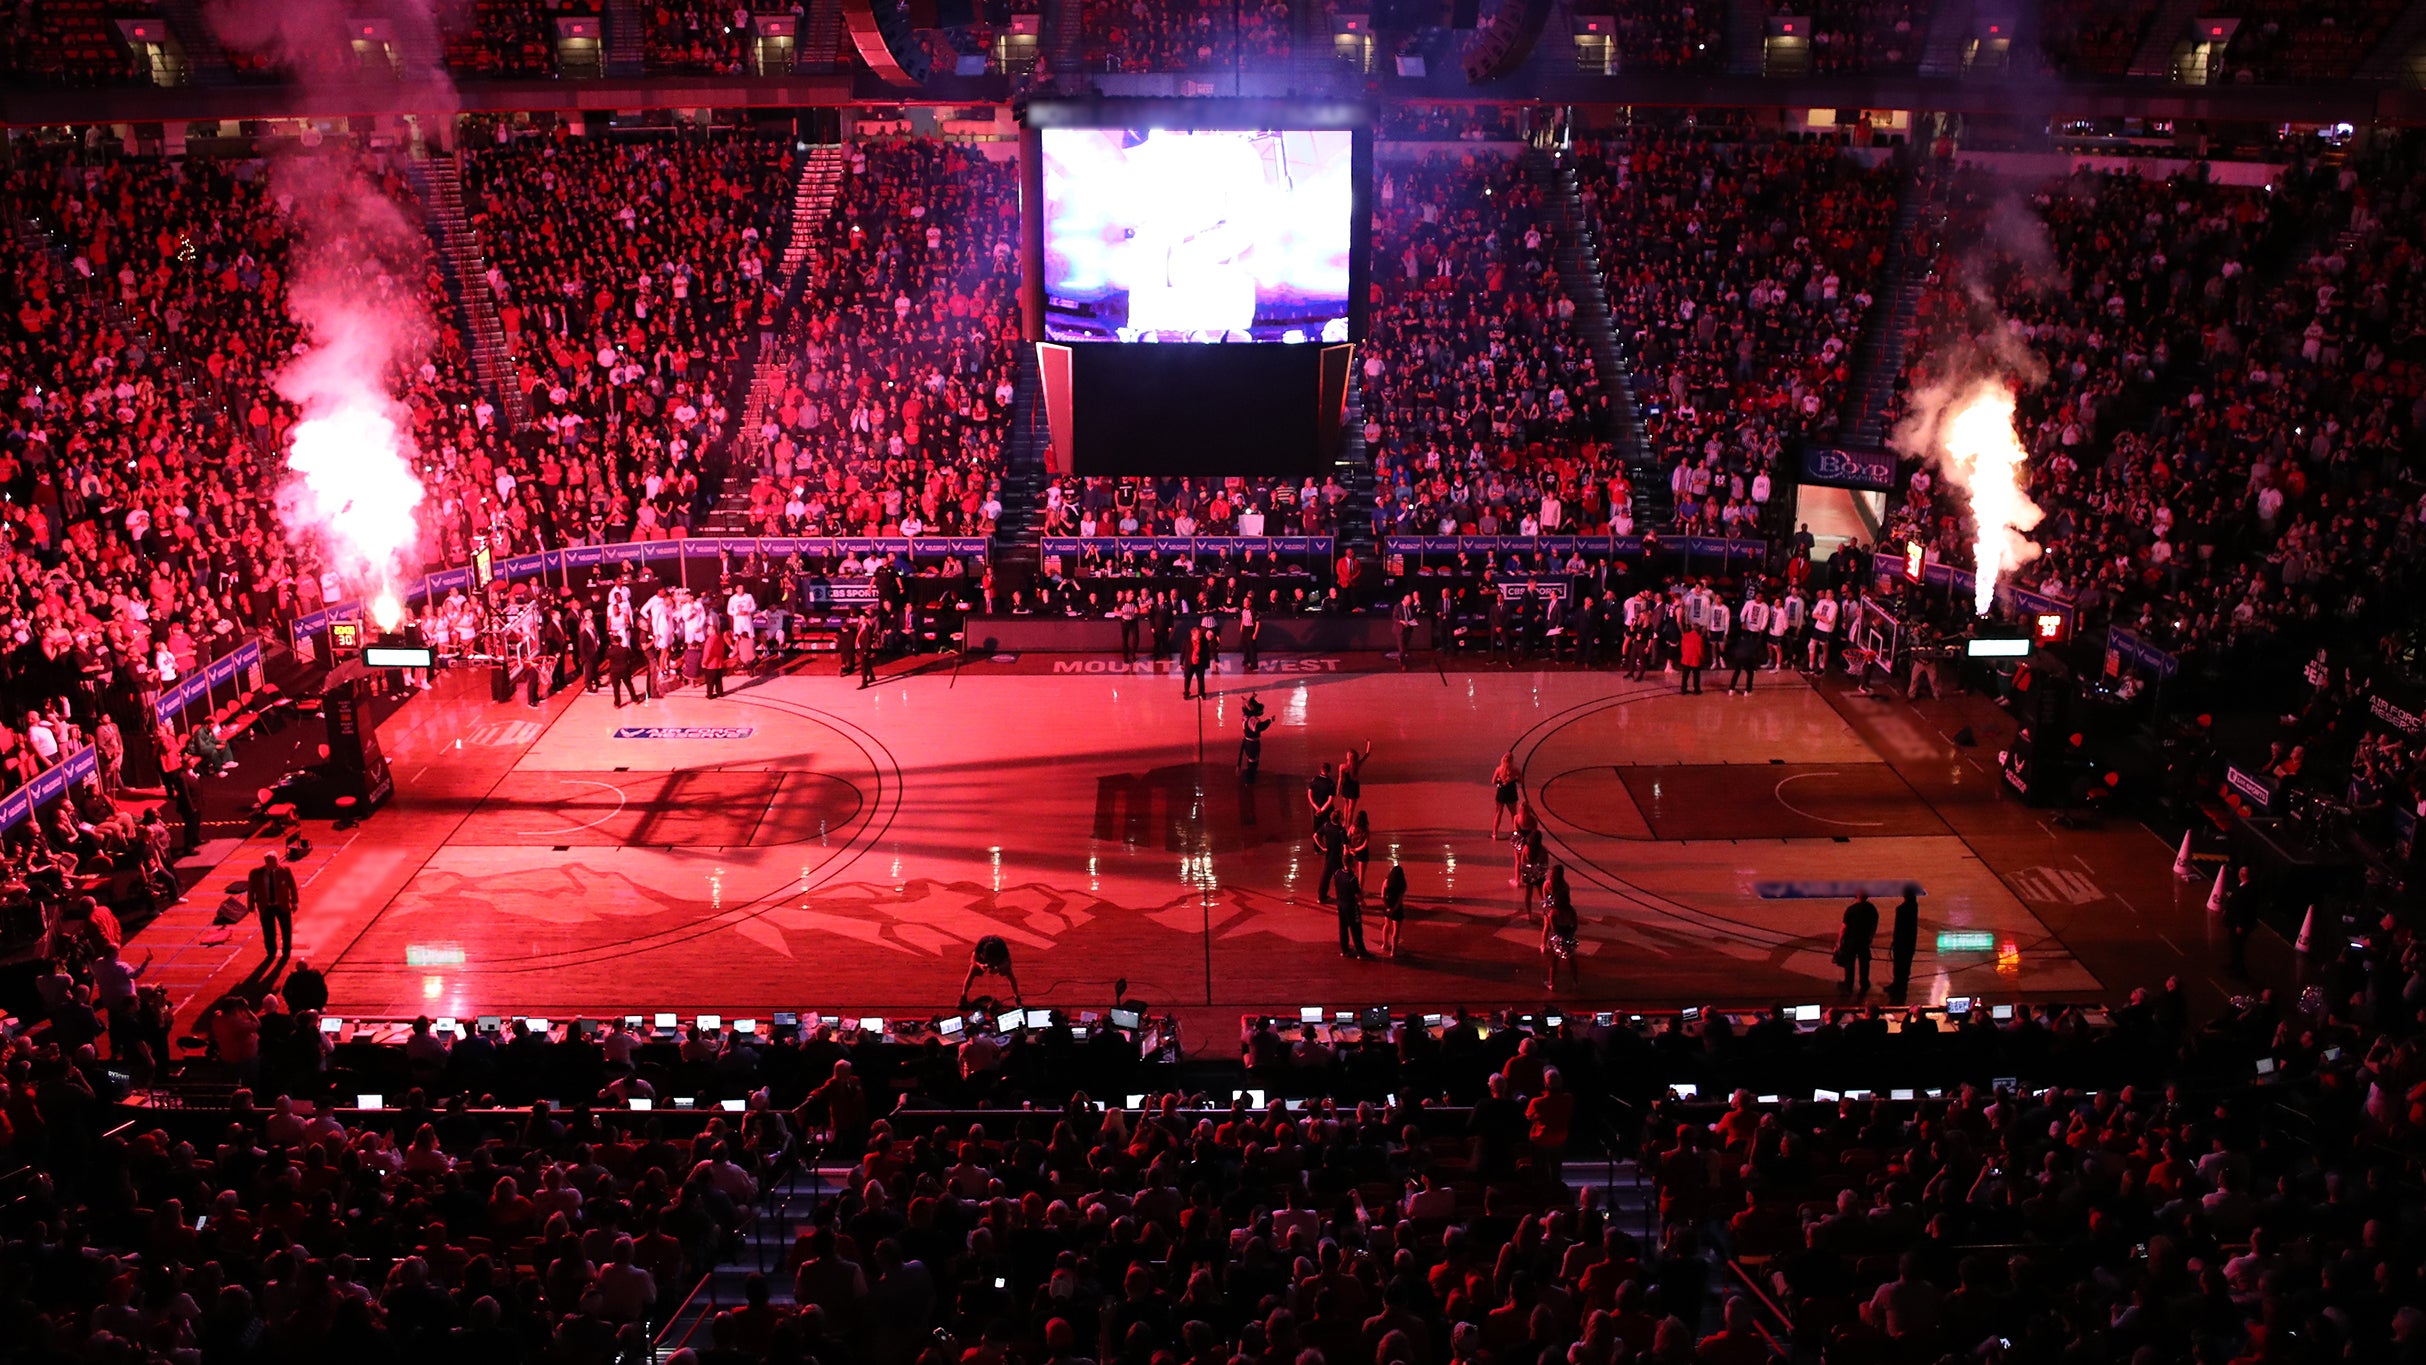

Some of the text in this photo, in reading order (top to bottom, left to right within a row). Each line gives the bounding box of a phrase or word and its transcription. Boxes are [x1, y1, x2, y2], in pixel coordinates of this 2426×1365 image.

[1819, 453, 1889, 476] BOYD
[1507, 587, 1525, 596] CBS
[339, 635, 352, 646] 30
[1052, 660, 1231, 673] MOUNTN
[2368, 694, 2389, 711] AIR
